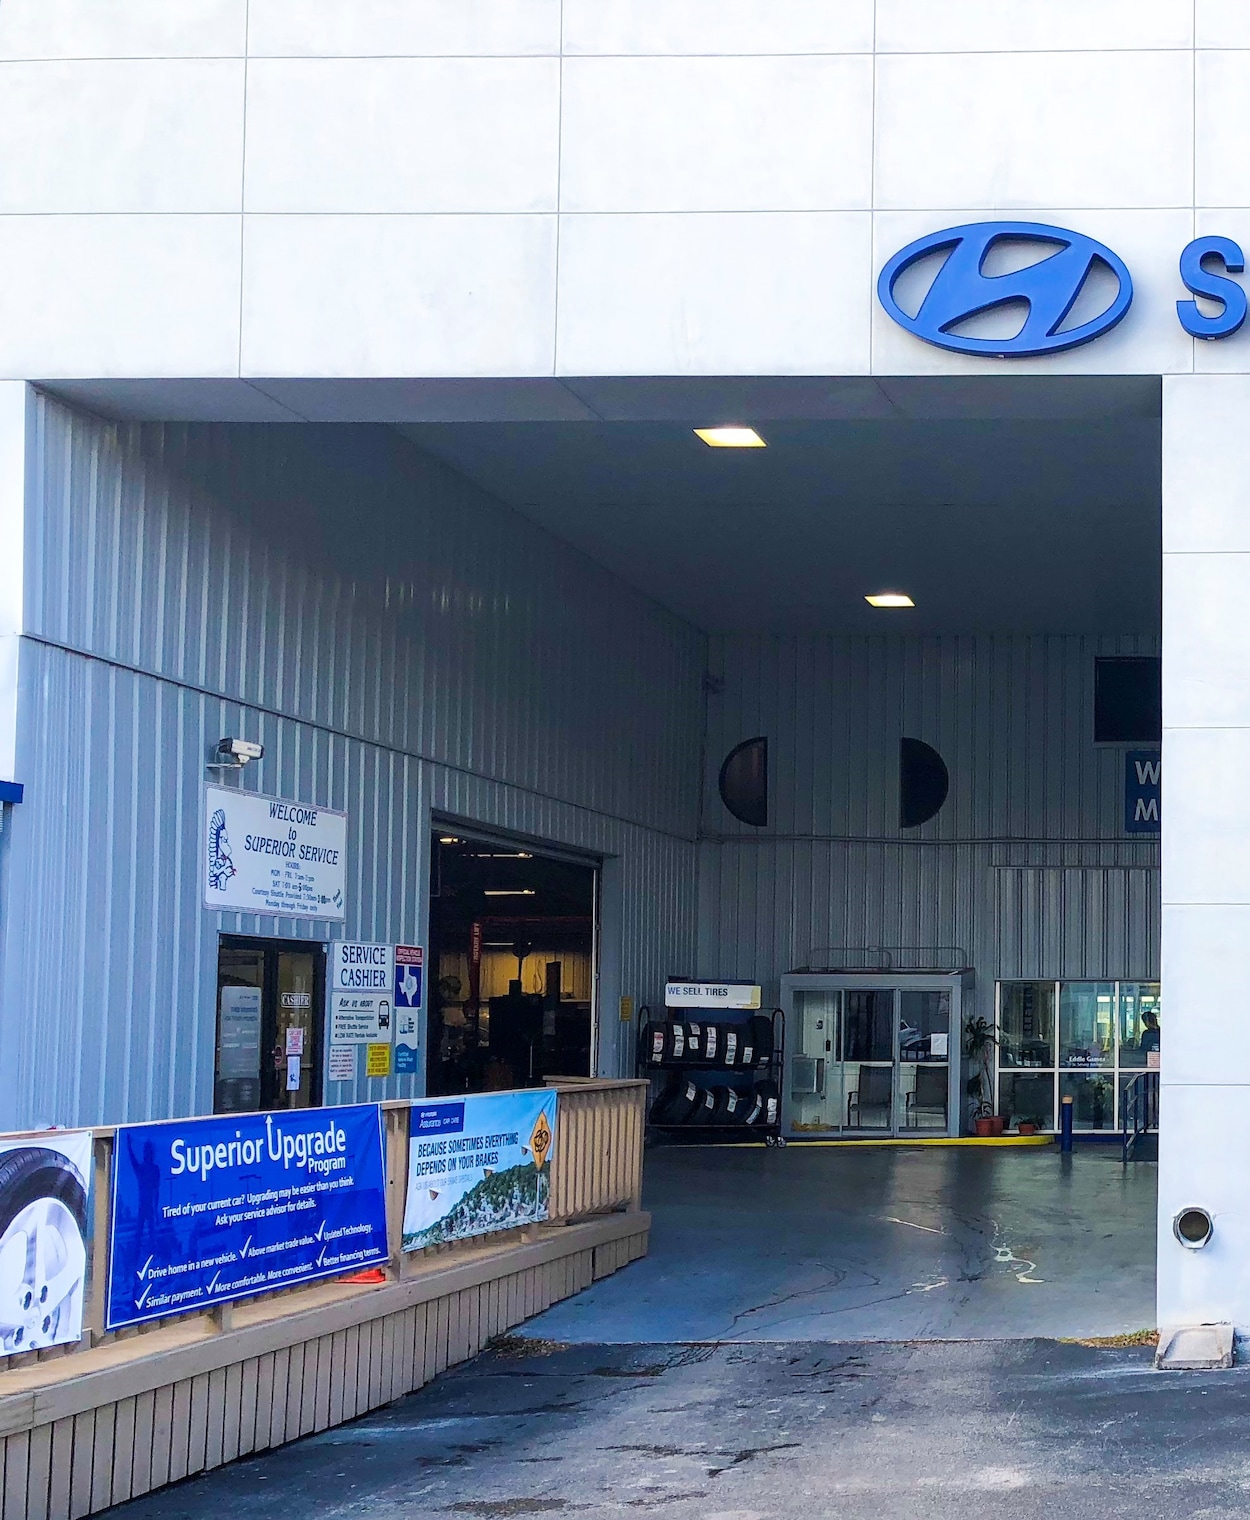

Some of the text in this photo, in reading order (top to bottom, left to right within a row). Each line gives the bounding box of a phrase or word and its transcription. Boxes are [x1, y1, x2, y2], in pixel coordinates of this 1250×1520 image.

[269, 802, 318, 826] WELCOME
[288, 827, 297, 841] to
[244, 834, 339, 866] SUPERIOR SERVICE
[341, 945, 386, 965] SERVICE
[340, 968, 386, 988] CASHIER
[282, 993, 310, 1006] CASHIER
[668, 986, 728, 997] WE SELL TIRES
[170, 1116, 346, 1182] Superior Upgrade
[417, 1131, 519, 1158] BECAUSE SOMETIMES EVERYTHING
[308, 1156, 346, 1176] Program
[416, 1151, 499, 1177] DEPENDS ON YOUR BRAKES
[162, 1204, 182, 1218] Tired
[182, 1202, 191, 1215] of
[191, 1203, 207, 1217] your
[207, 1198, 231, 1211] current
[232, 1194, 245, 1207] car?
[247, 1188, 278, 1205] Upgrading
[279, 1189, 291, 1200] may
[291, 1186, 299, 1196] be
[299, 1183, 317, 1194] easier
[316, 1181, 329, 1192] than
[328, 1181, 339, 1192] you
[215, 1199, 317, 1226] Ask your service advisor for details.
[323, 1223, 373, 1242] Updated Technology.
[248, 1235, 315, 1257] Above market trade value.
[148, 1251, 238, 1279] Drive home in a new vehicle.
[323, 1257, 340, 1267] Better
[340, 1250, 364, 1263] financing
[214, 1262, 313, 1294] More comfortable. More convenient.
[146, 1287, 204, 1308] Similar payment.
